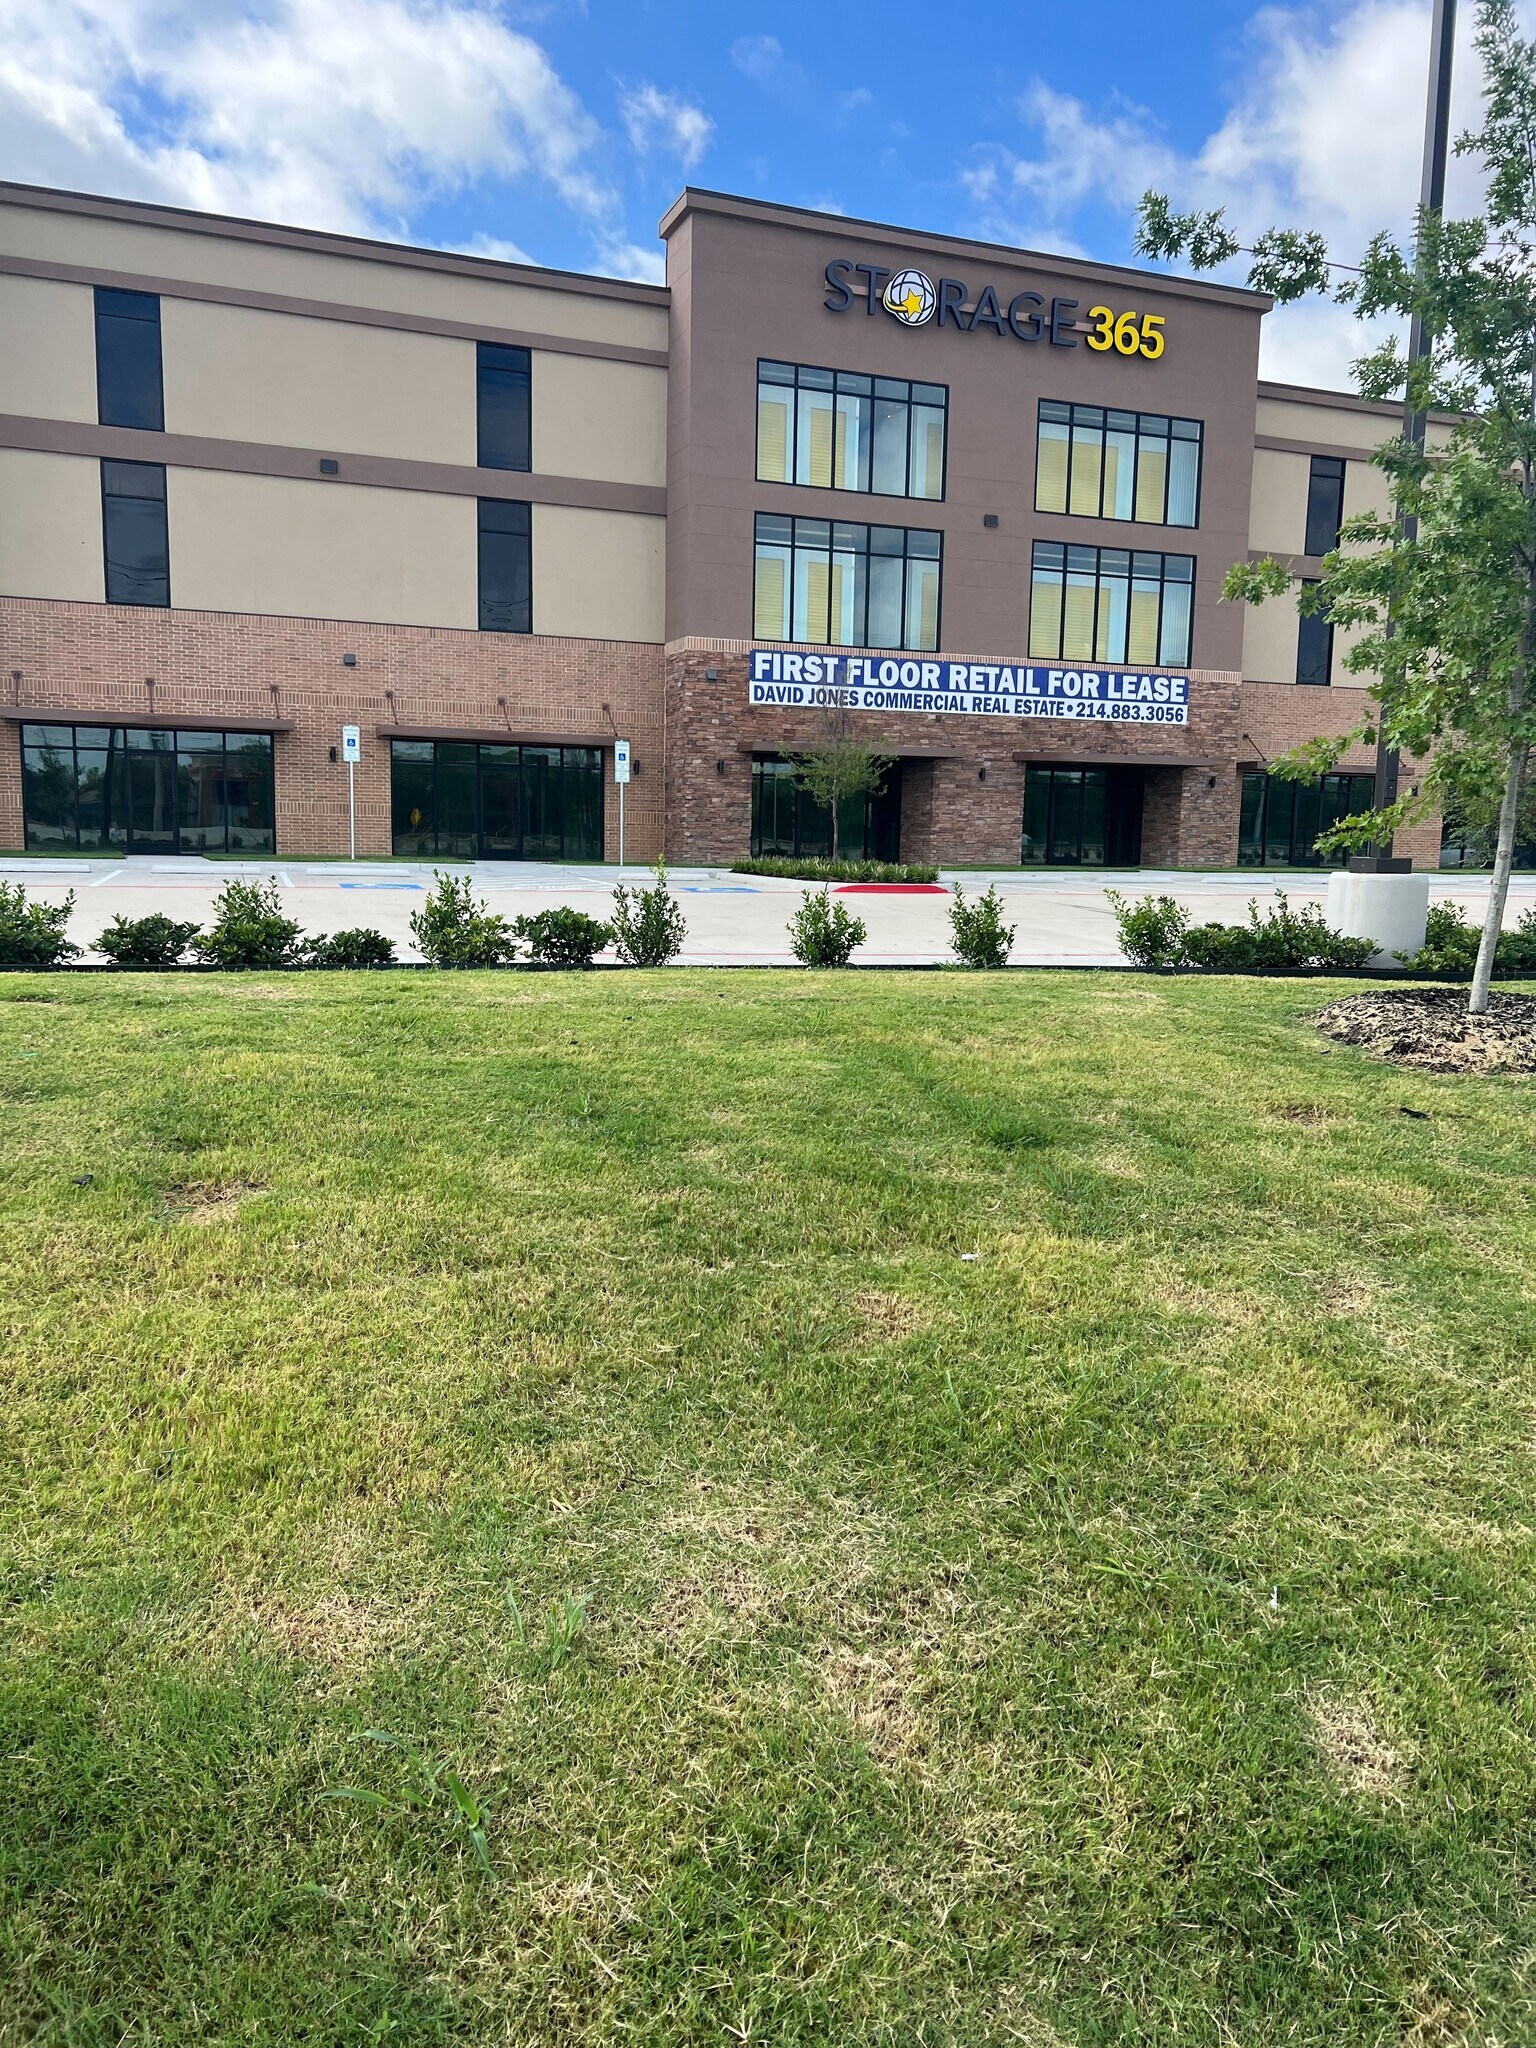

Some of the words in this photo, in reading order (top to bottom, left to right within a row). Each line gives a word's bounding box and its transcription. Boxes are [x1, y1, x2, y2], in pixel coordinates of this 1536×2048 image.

[824, 259, 1078, 348] STORAGE
[1087, 306, 1165, 359] 365
[754, 652, 838, 684] FIRST
[847, 658, 941, 689] FLOOR
[949, 663, 1040, 695] RETAIL
[1048, 670, 1100, 698] FOR
[1107, 674, 1185, 703] LEASE
[753, 685, 804, 702] DAVID
[808, 687, 859, 706] JONES
[863, 691, 968, 712] COMMERCIAL
[972, 697, 1010, 714] REAL
[1014, 699, 1064, 717] ESTATE
[1076, 702, 1184, 723] 214.883.3056
